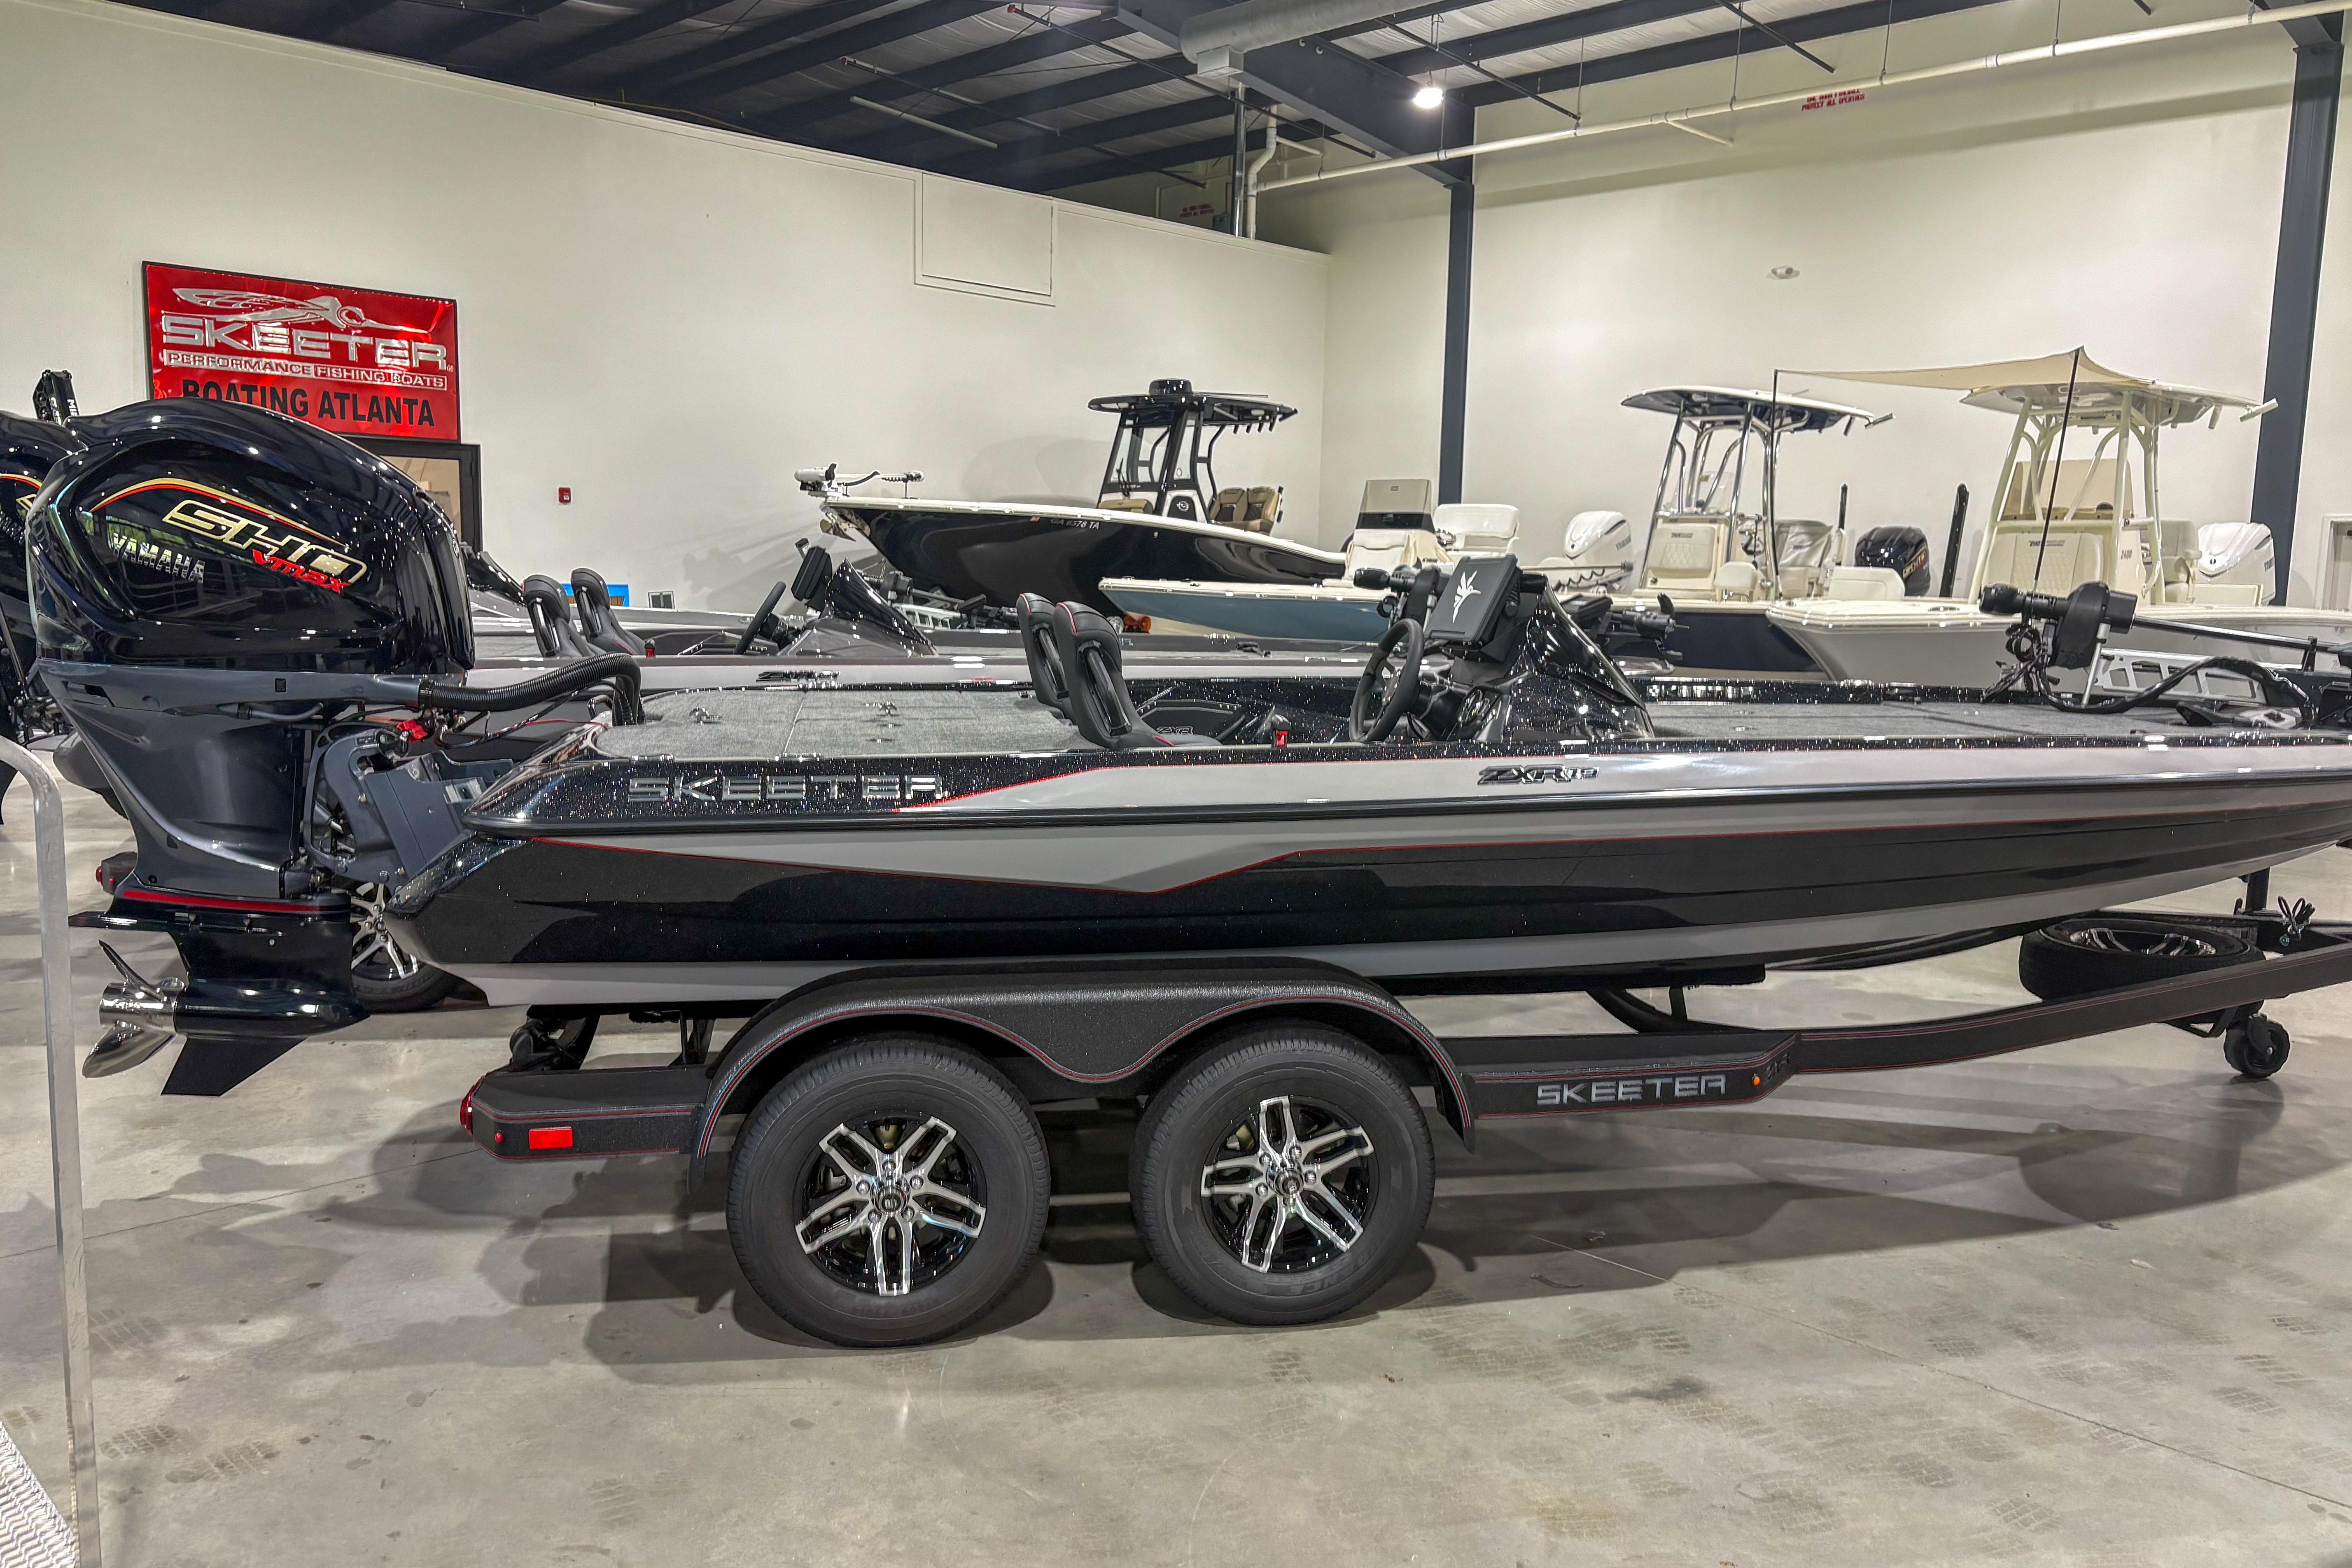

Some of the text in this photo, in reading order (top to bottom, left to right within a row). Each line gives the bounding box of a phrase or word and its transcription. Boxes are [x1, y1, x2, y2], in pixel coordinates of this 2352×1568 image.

[162, 315, 446, 370] SKEETER
[170, 353, 443, 387] PERFORMANCE FISHING BOATS
[182, 379, 434, 427] BOATING ATLANTA
[162, 500, 367, 584] SHO
[1089, 521, 1100, 530] TA
[113, 533, 205, 583] YAMAHA
[629, 775, 943, 802] SKEETER
[1537, 1074, 1726, 1105] SKEETER
